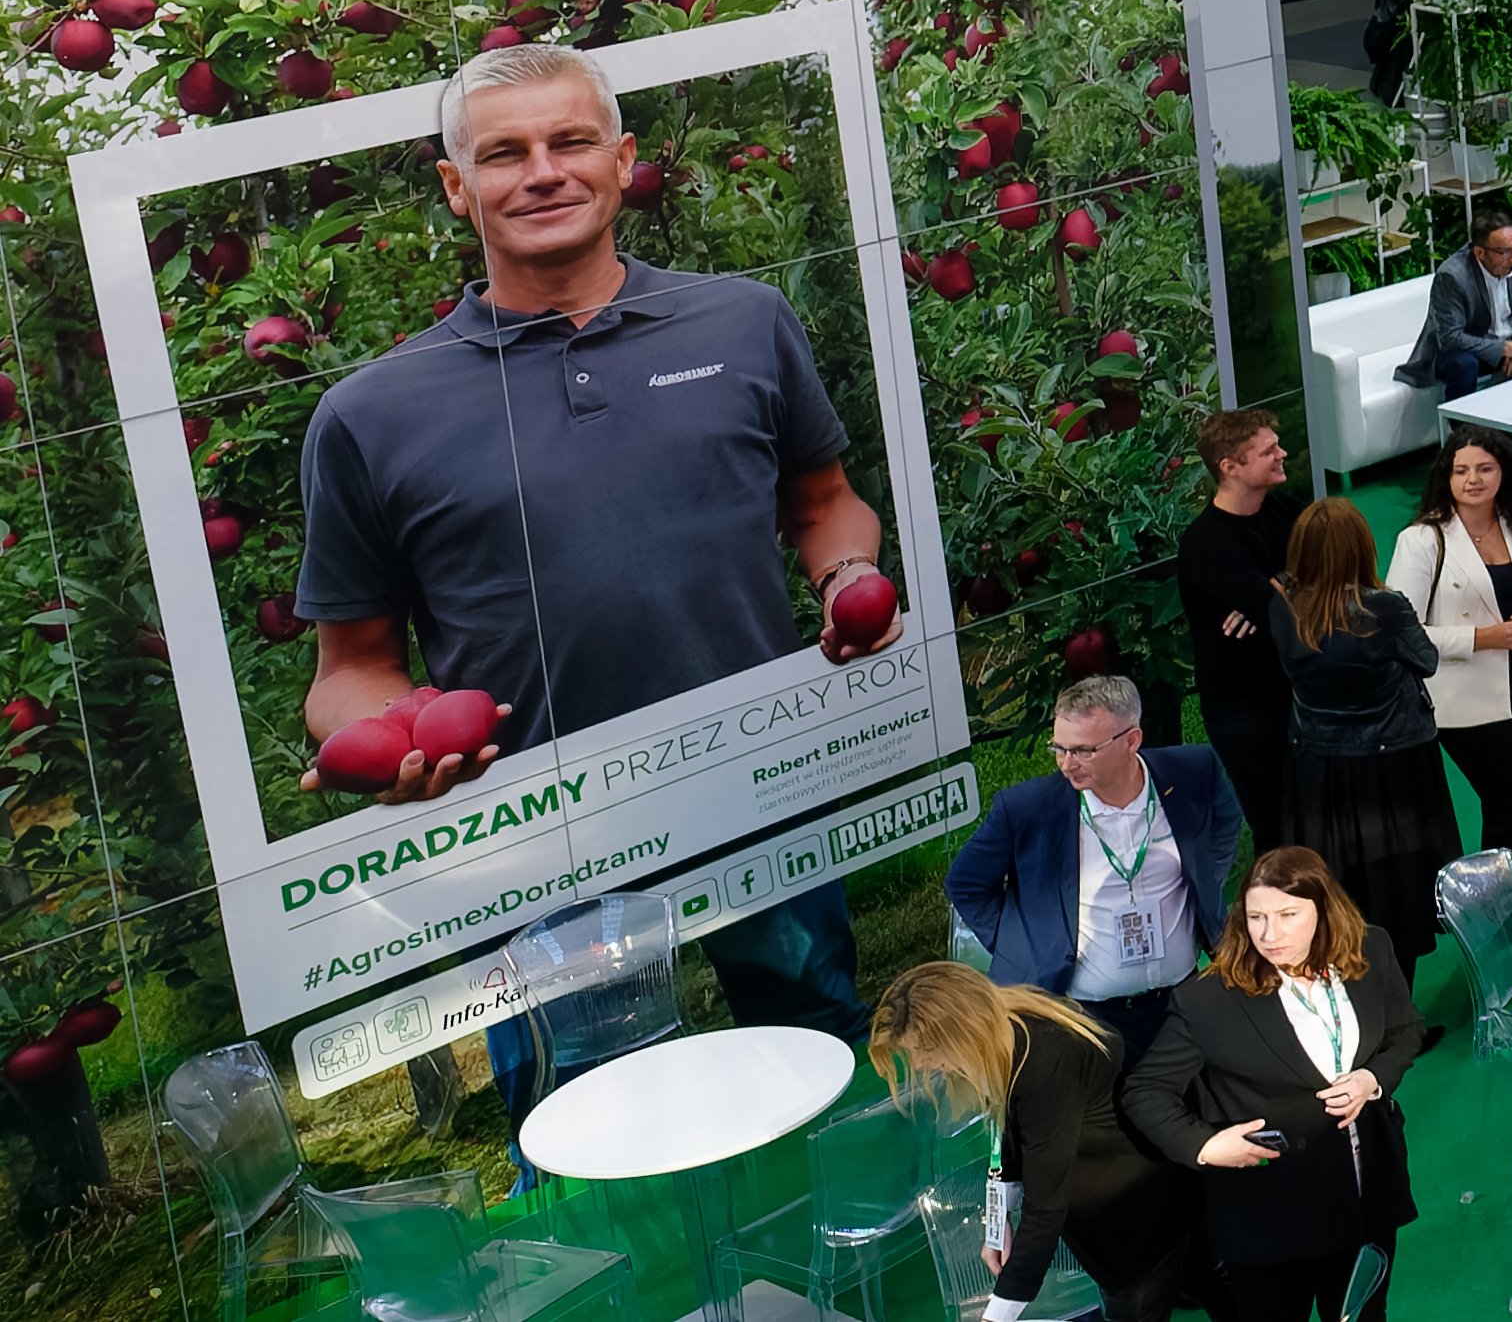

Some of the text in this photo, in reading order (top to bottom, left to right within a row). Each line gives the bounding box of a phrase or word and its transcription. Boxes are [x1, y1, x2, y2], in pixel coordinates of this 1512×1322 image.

[281, 649, 921, 912] DORADZAMY PRZEZ CAŁY ROK
[753, 708, 930, 784] Robert Binkiewicz
[304, 831, 670, 992] #AgrosimexDoradzamy
